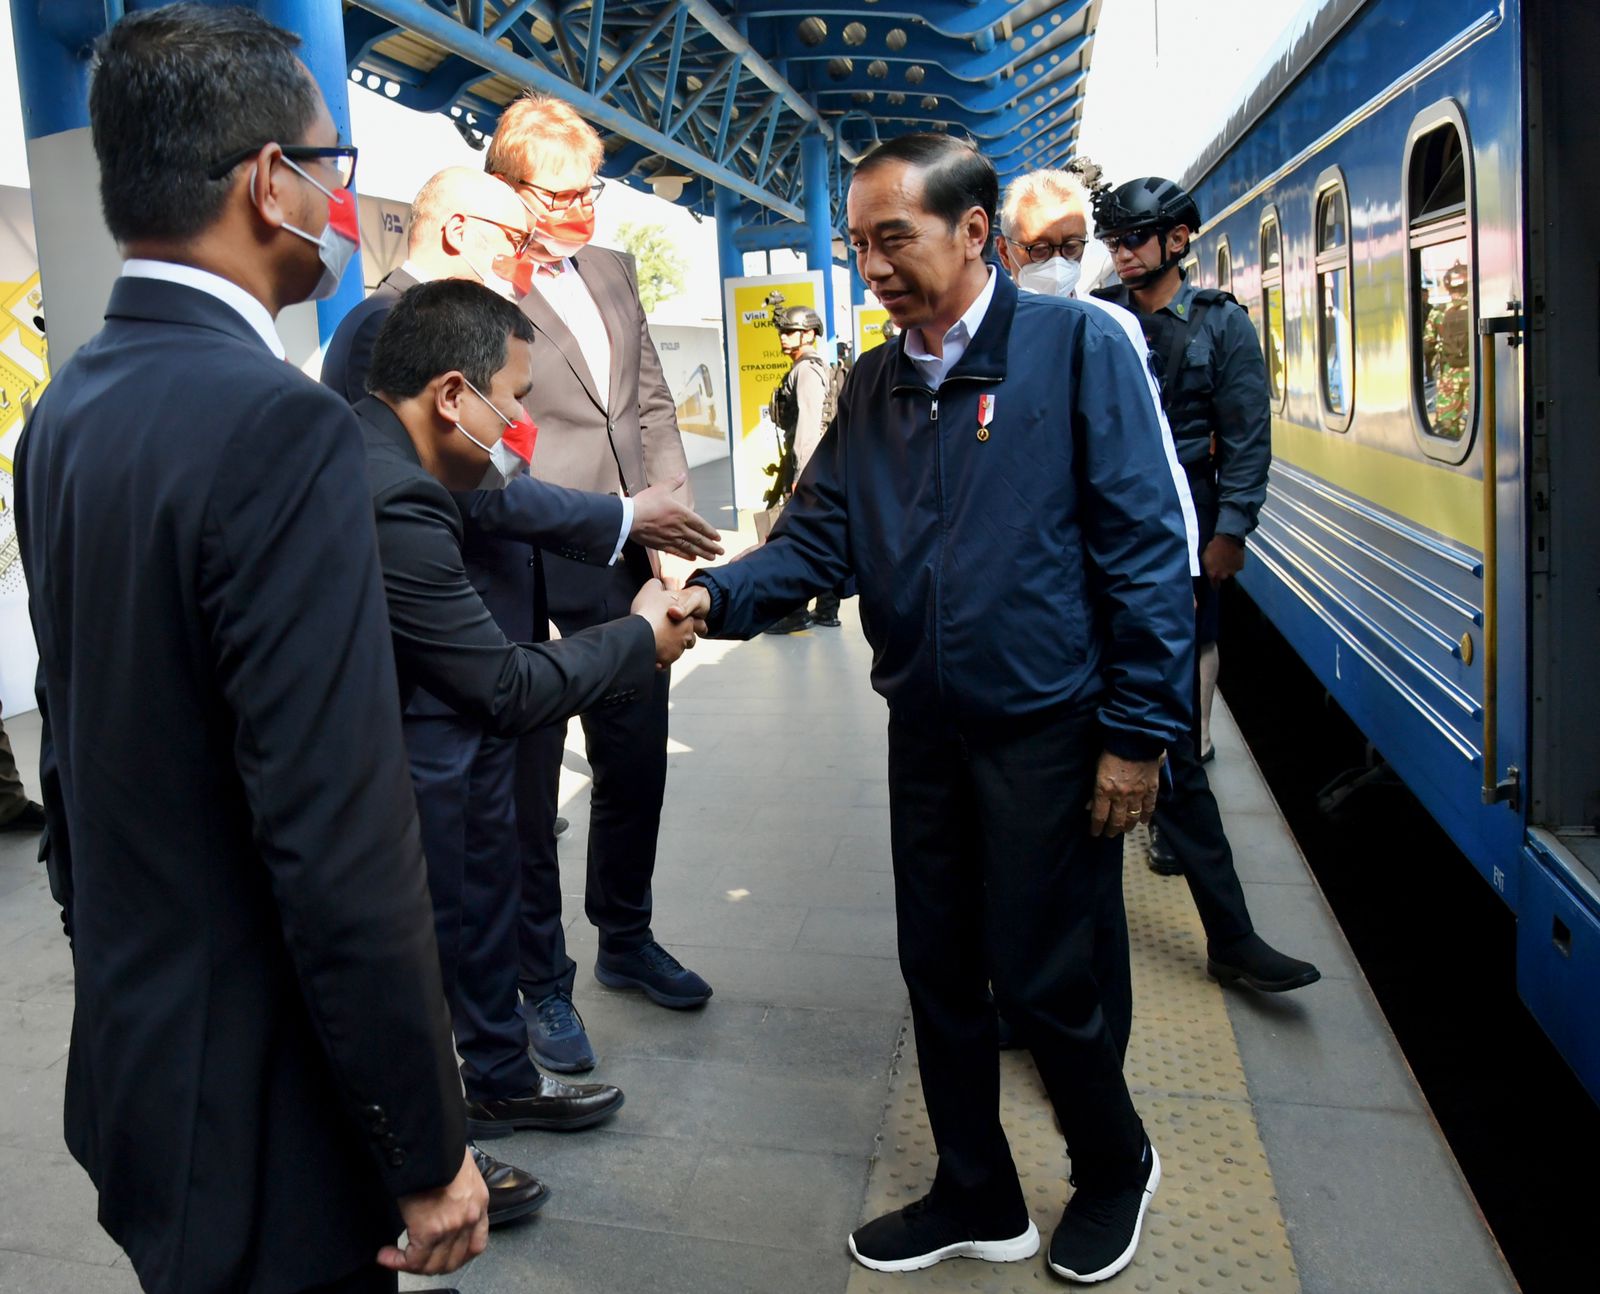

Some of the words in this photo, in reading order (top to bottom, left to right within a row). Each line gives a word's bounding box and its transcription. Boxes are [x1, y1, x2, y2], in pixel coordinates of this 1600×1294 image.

[744, 312, 766, 320] Visit
[753, 320, 774, 329] UKR
[741, 361, 788, 371] СТРАХОВИЙ
[755, 373, 783, 382] ОБРА
